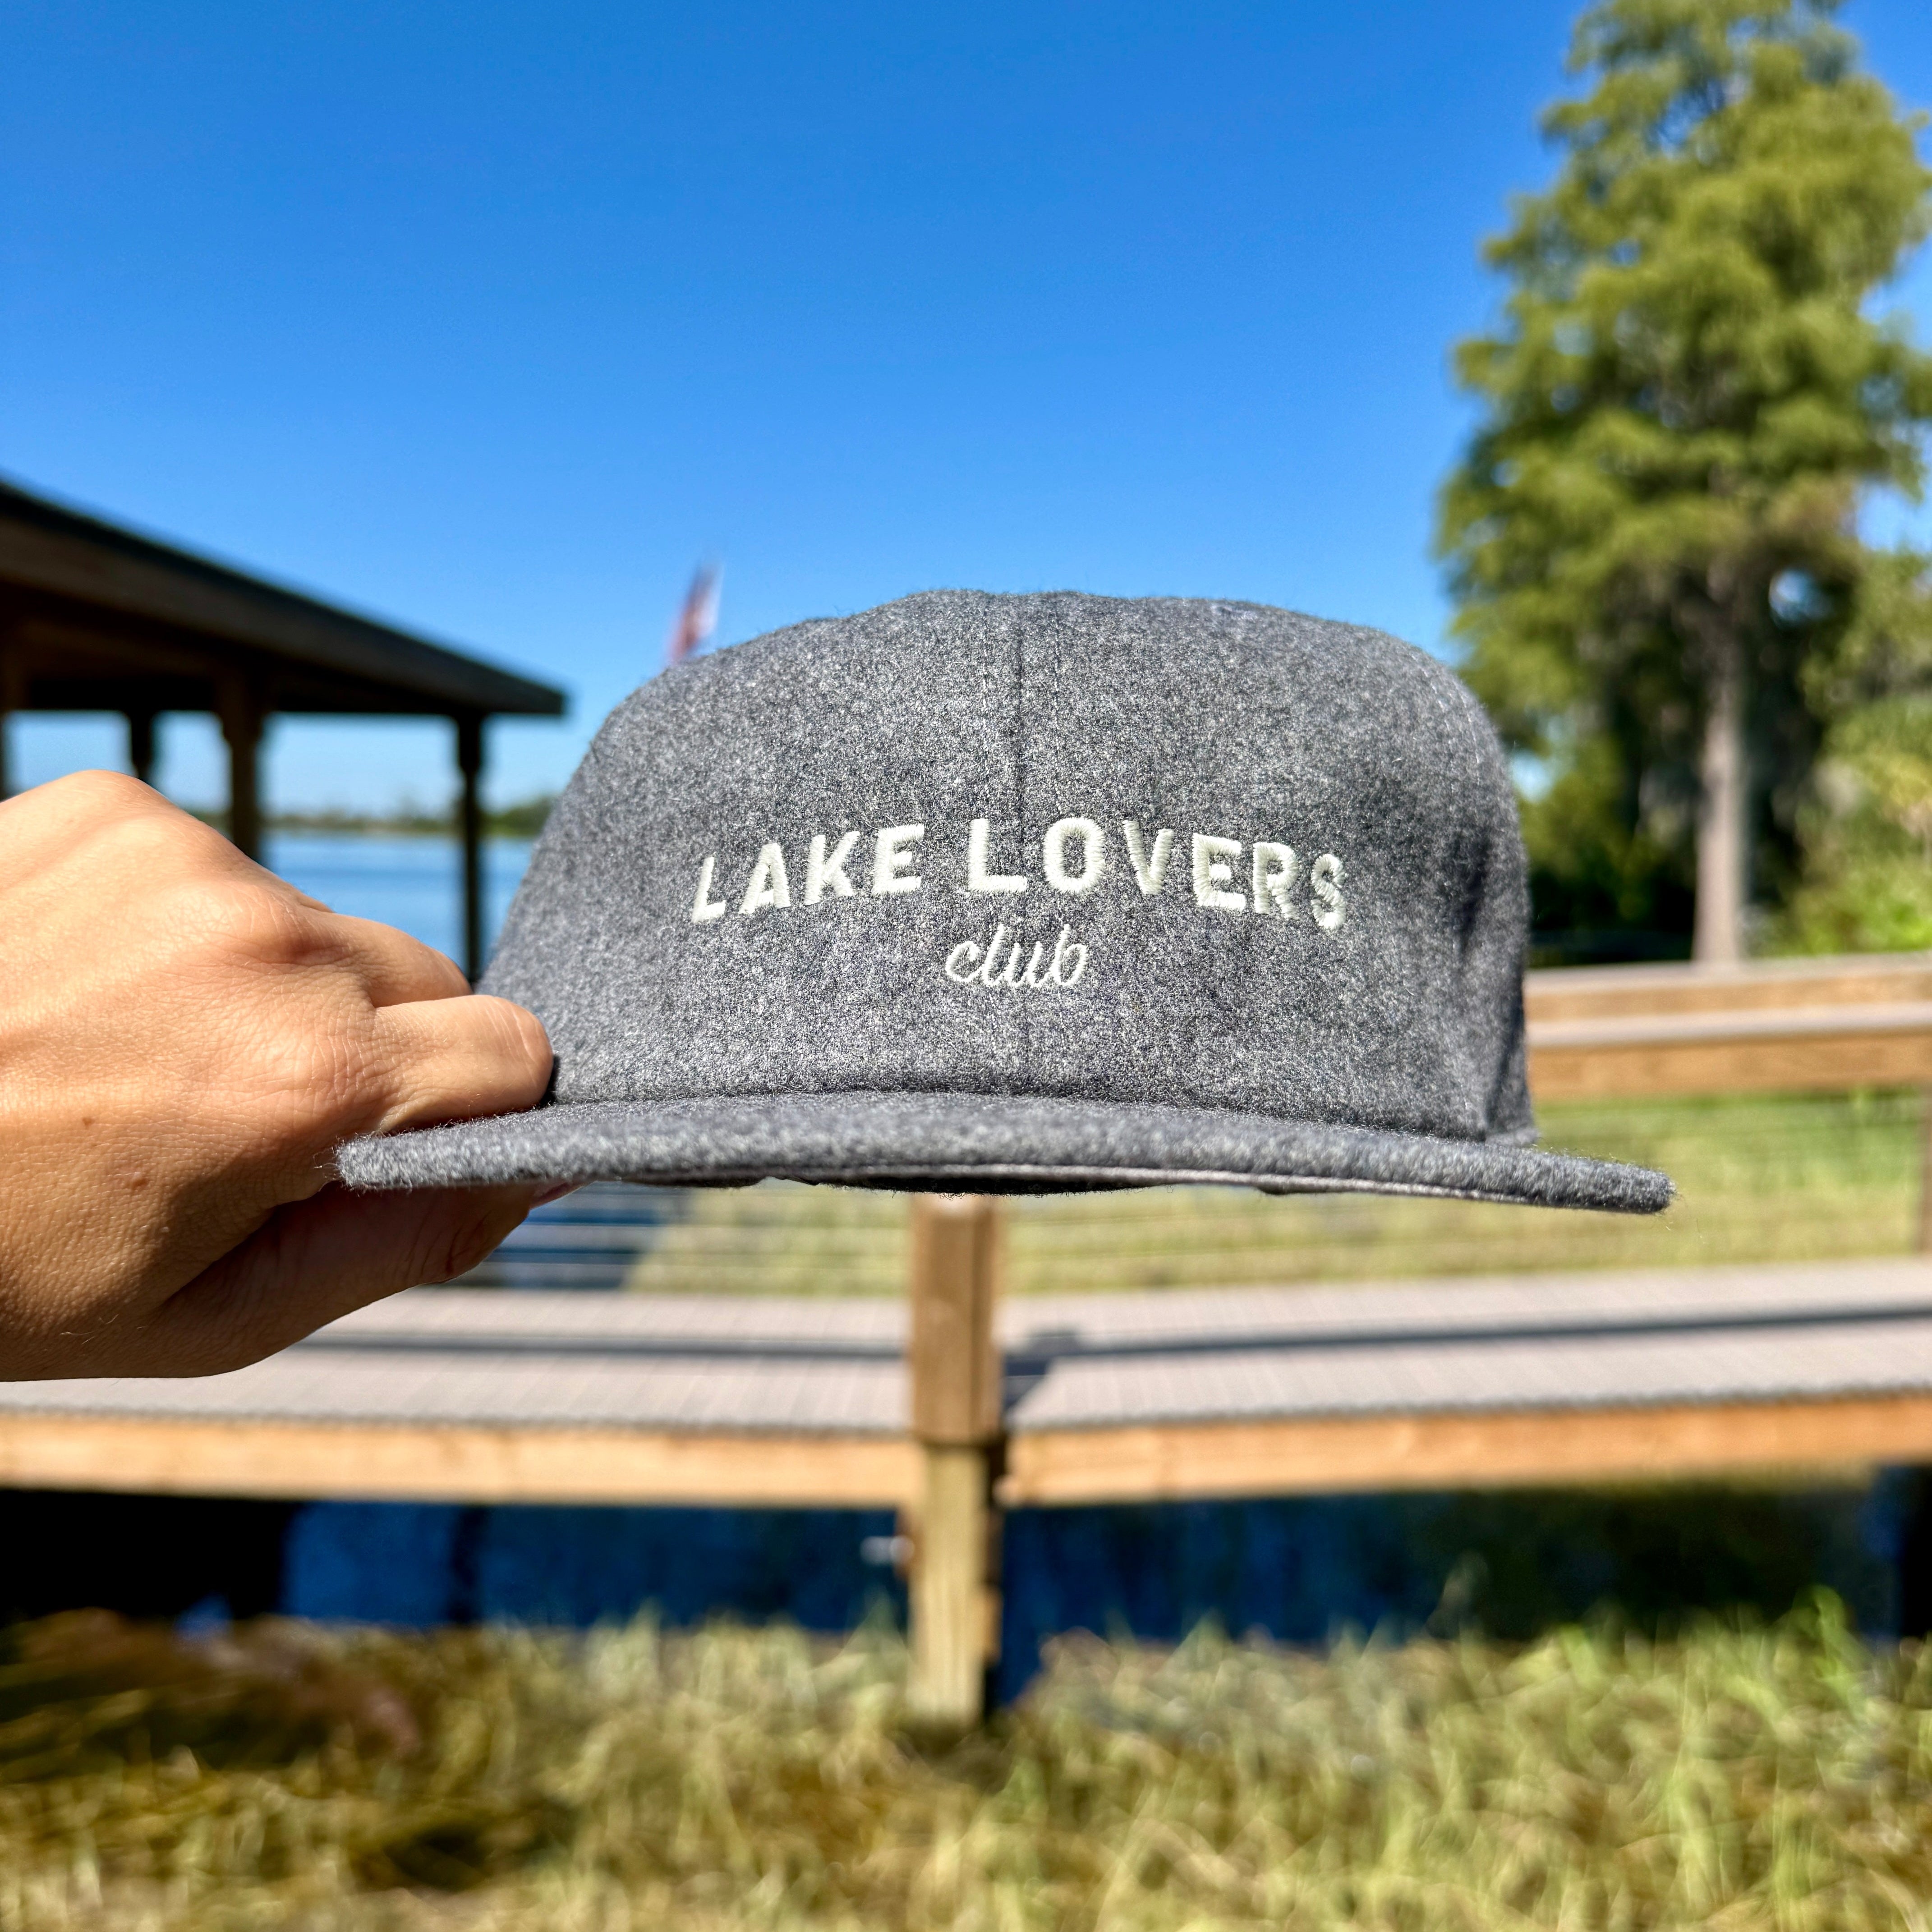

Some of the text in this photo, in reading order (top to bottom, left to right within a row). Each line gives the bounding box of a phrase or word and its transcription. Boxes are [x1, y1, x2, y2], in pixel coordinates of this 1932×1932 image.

[691, 816, 1346, 930] LAKE LOVERS
[944, 924, 1088, 989] club
